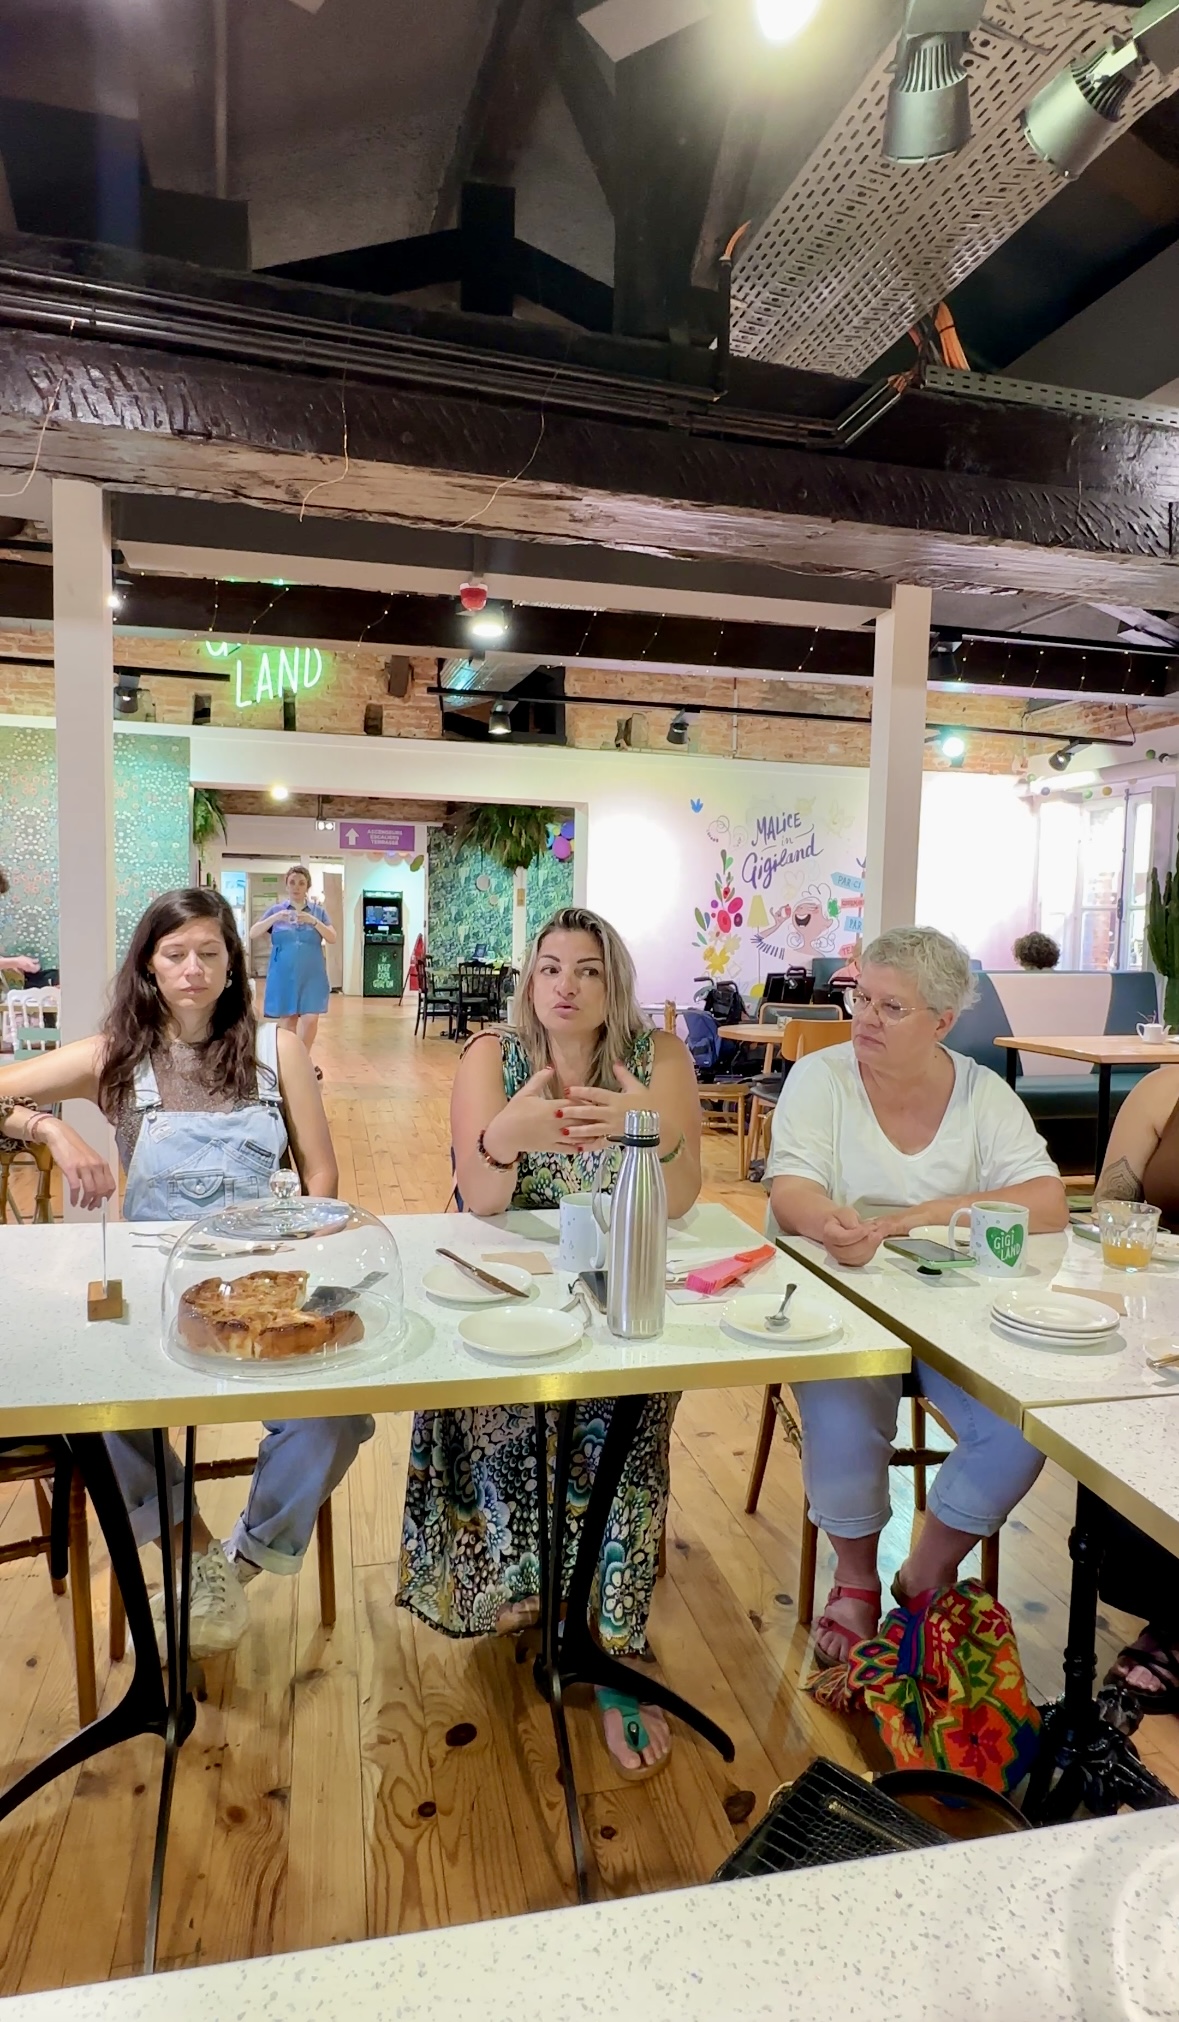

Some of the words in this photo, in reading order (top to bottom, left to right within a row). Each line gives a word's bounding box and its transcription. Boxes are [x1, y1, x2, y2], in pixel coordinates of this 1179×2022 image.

[236, 646, 323, 707] LAND
[781, 836, 794, 846] in
[742, 833, 824, 890] Gigiland
[1001, 1243, 1021, 1261] LAND
